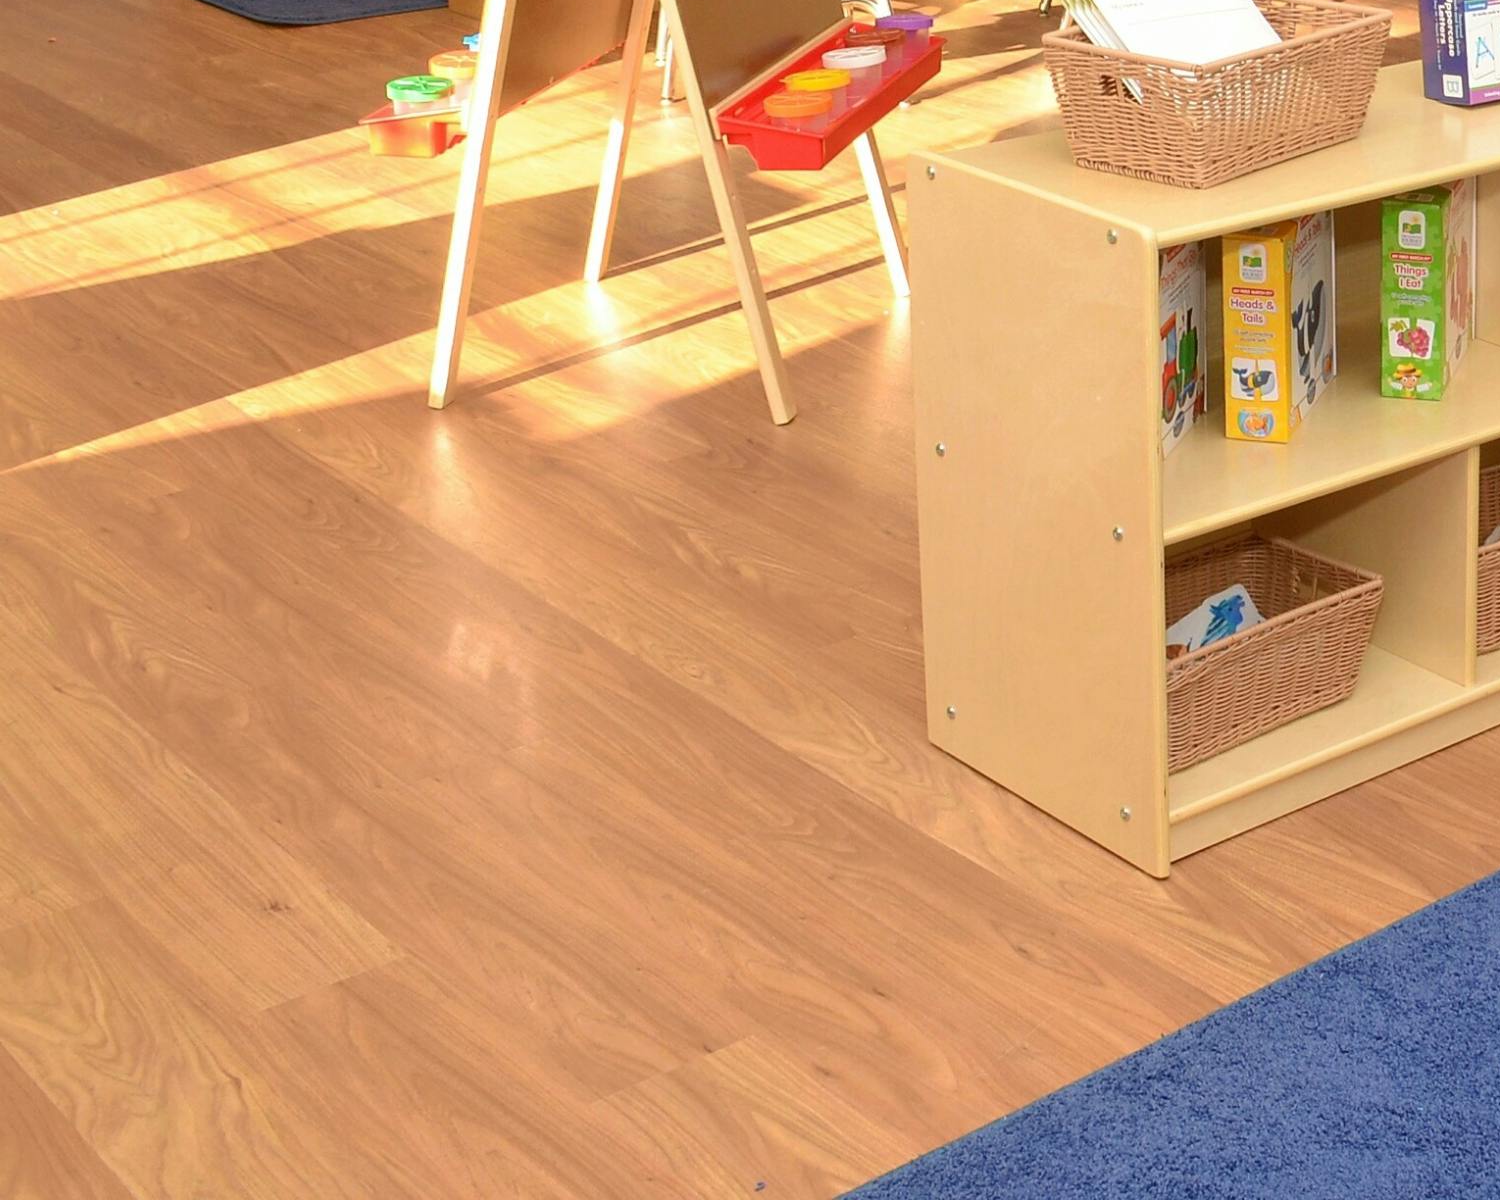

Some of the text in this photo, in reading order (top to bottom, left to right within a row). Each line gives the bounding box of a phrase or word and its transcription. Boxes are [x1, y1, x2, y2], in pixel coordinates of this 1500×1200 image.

[1395, 264, 1427, 277] Things
[1400, 279, 1421, 288] I Eat
[1230, 299, 1274, 311] Heads &
[1242, 313, 1264, 324] Tails
